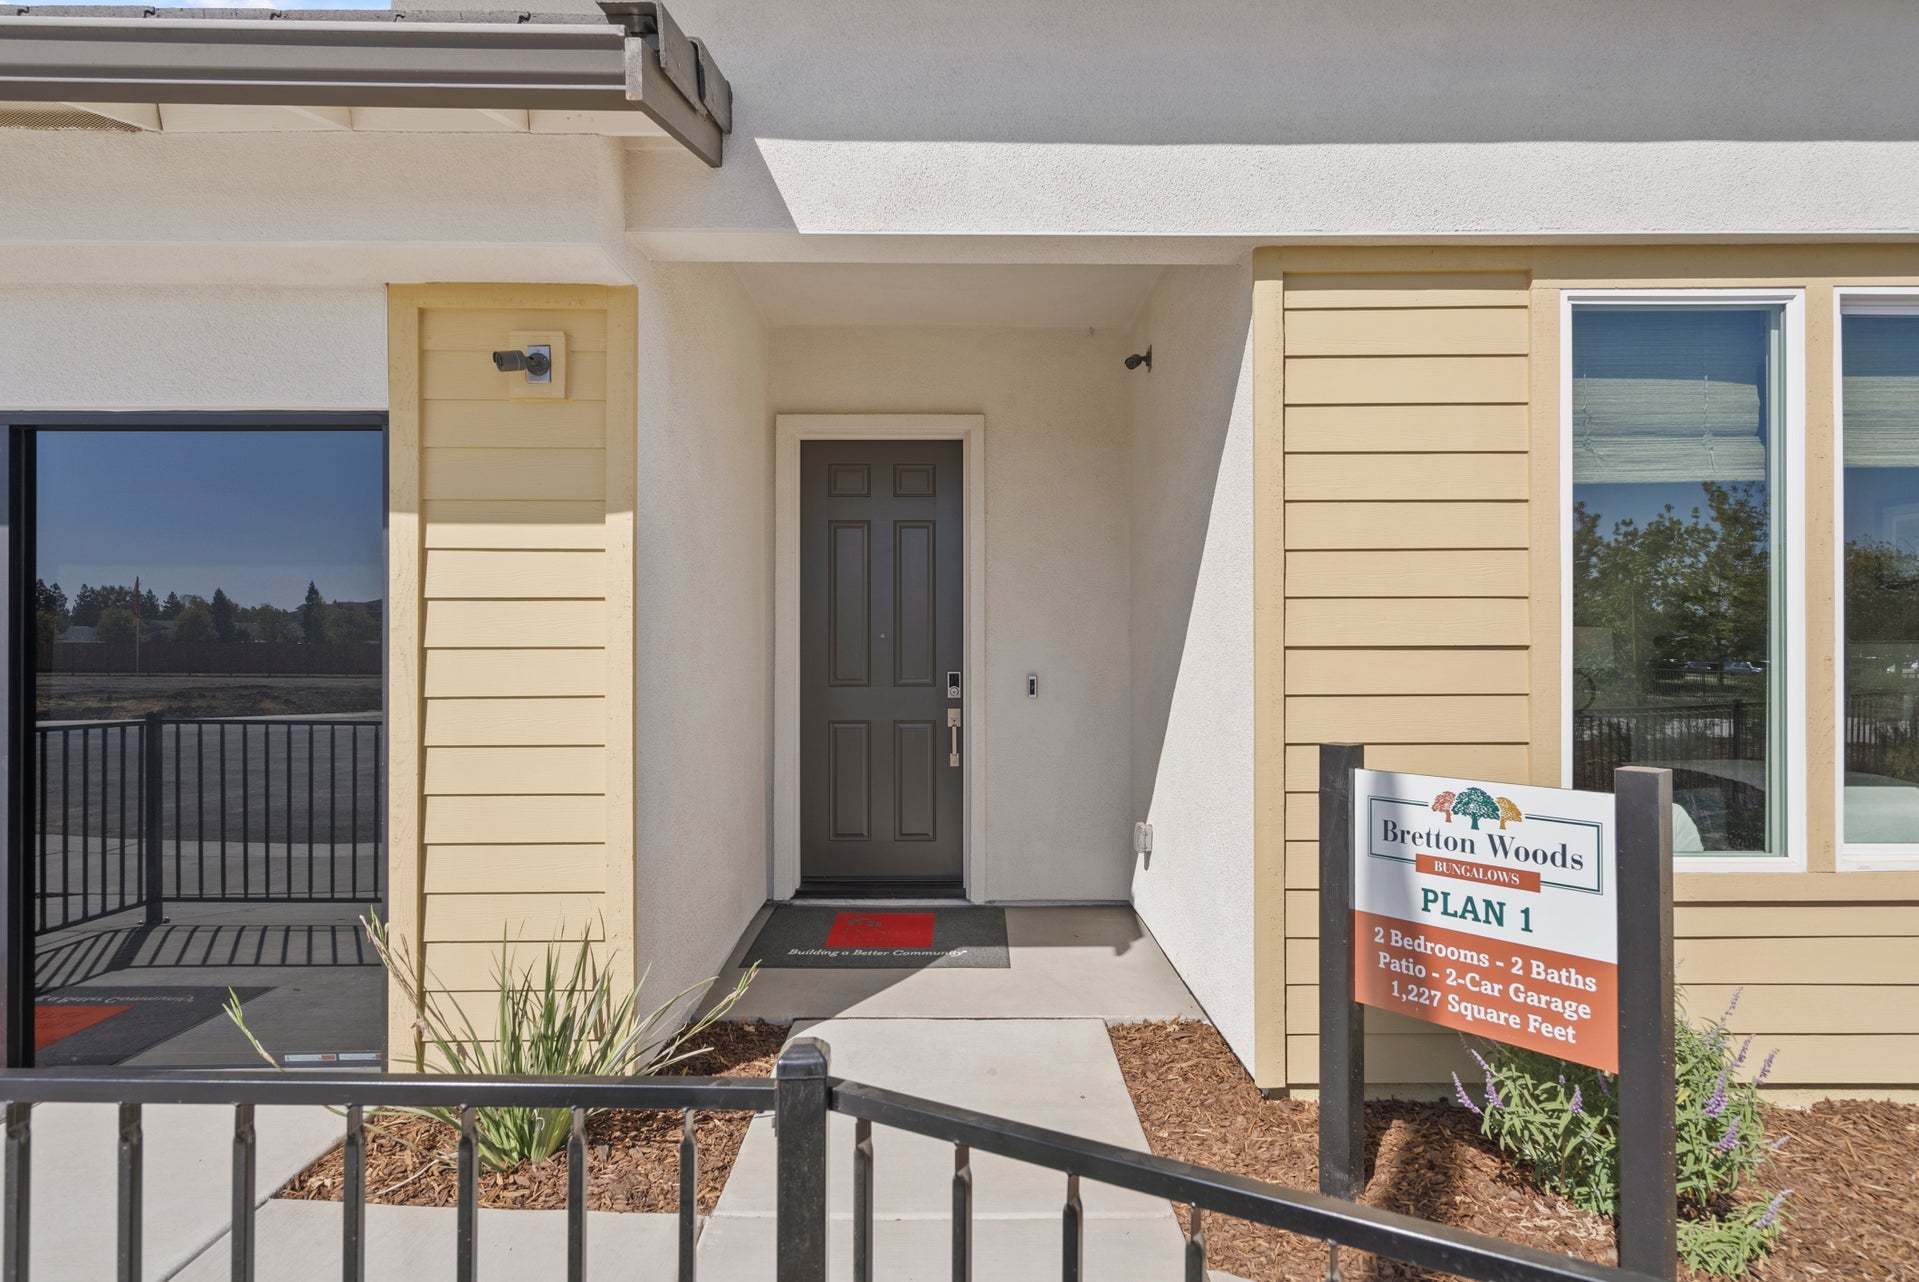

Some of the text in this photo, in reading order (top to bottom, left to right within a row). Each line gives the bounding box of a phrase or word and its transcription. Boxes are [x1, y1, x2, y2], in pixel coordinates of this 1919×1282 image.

[1383, 819, 1584, 871] Bretton Woods
[1434, 860, 1520, 886] BUNGALOWS
[1421, 887, 1533, 933] PLAN 1
[788, 948, 839, 957] Building
[853, 948, 890, 957] Better
[892, 949, 968, 958] Community
[1374, 926, 1385, 944] 2
[1390, 929, 1489, 968] Bedrooms
[1511, 956, 1524, 976] 2
[1531, 960, 1597, 992] Baths
[1378, 951, 1427, 979] Patio
[1446, 968, 1503, 998] 2-Car
[1509, 983, 1591, 1021] Garage
[1391, 981, 1576, 1044] 1,227 Square Feet
